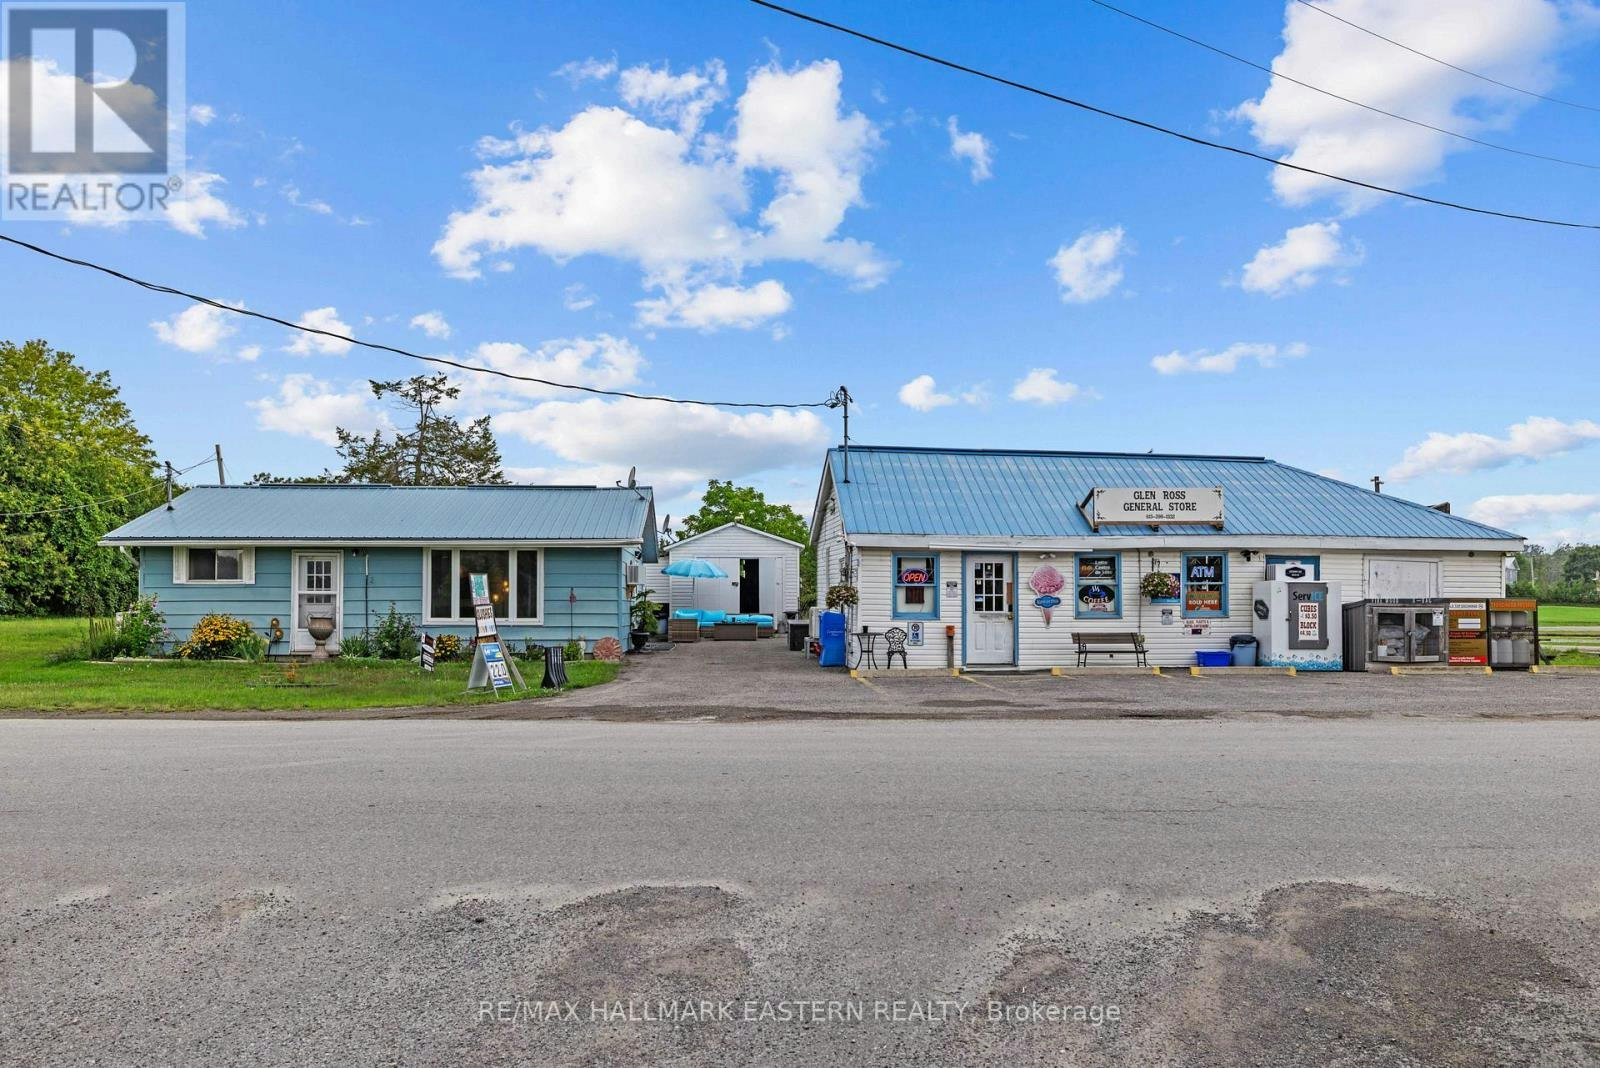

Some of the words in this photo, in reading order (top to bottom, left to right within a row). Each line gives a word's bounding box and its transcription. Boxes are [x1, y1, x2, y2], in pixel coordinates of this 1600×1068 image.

[1133, 491, 1156, 500] GLEN
[1163, 491, 1186, 500] ROSS
[1123, 503, 1163, 511] GENERAL
[1168, 502, 1197, 511] STORE
[1191, 565, 1215, 578] ATM
[903, 573, 926, 582] OPEN
[1083, 595, 1110, 603] COFFEE
